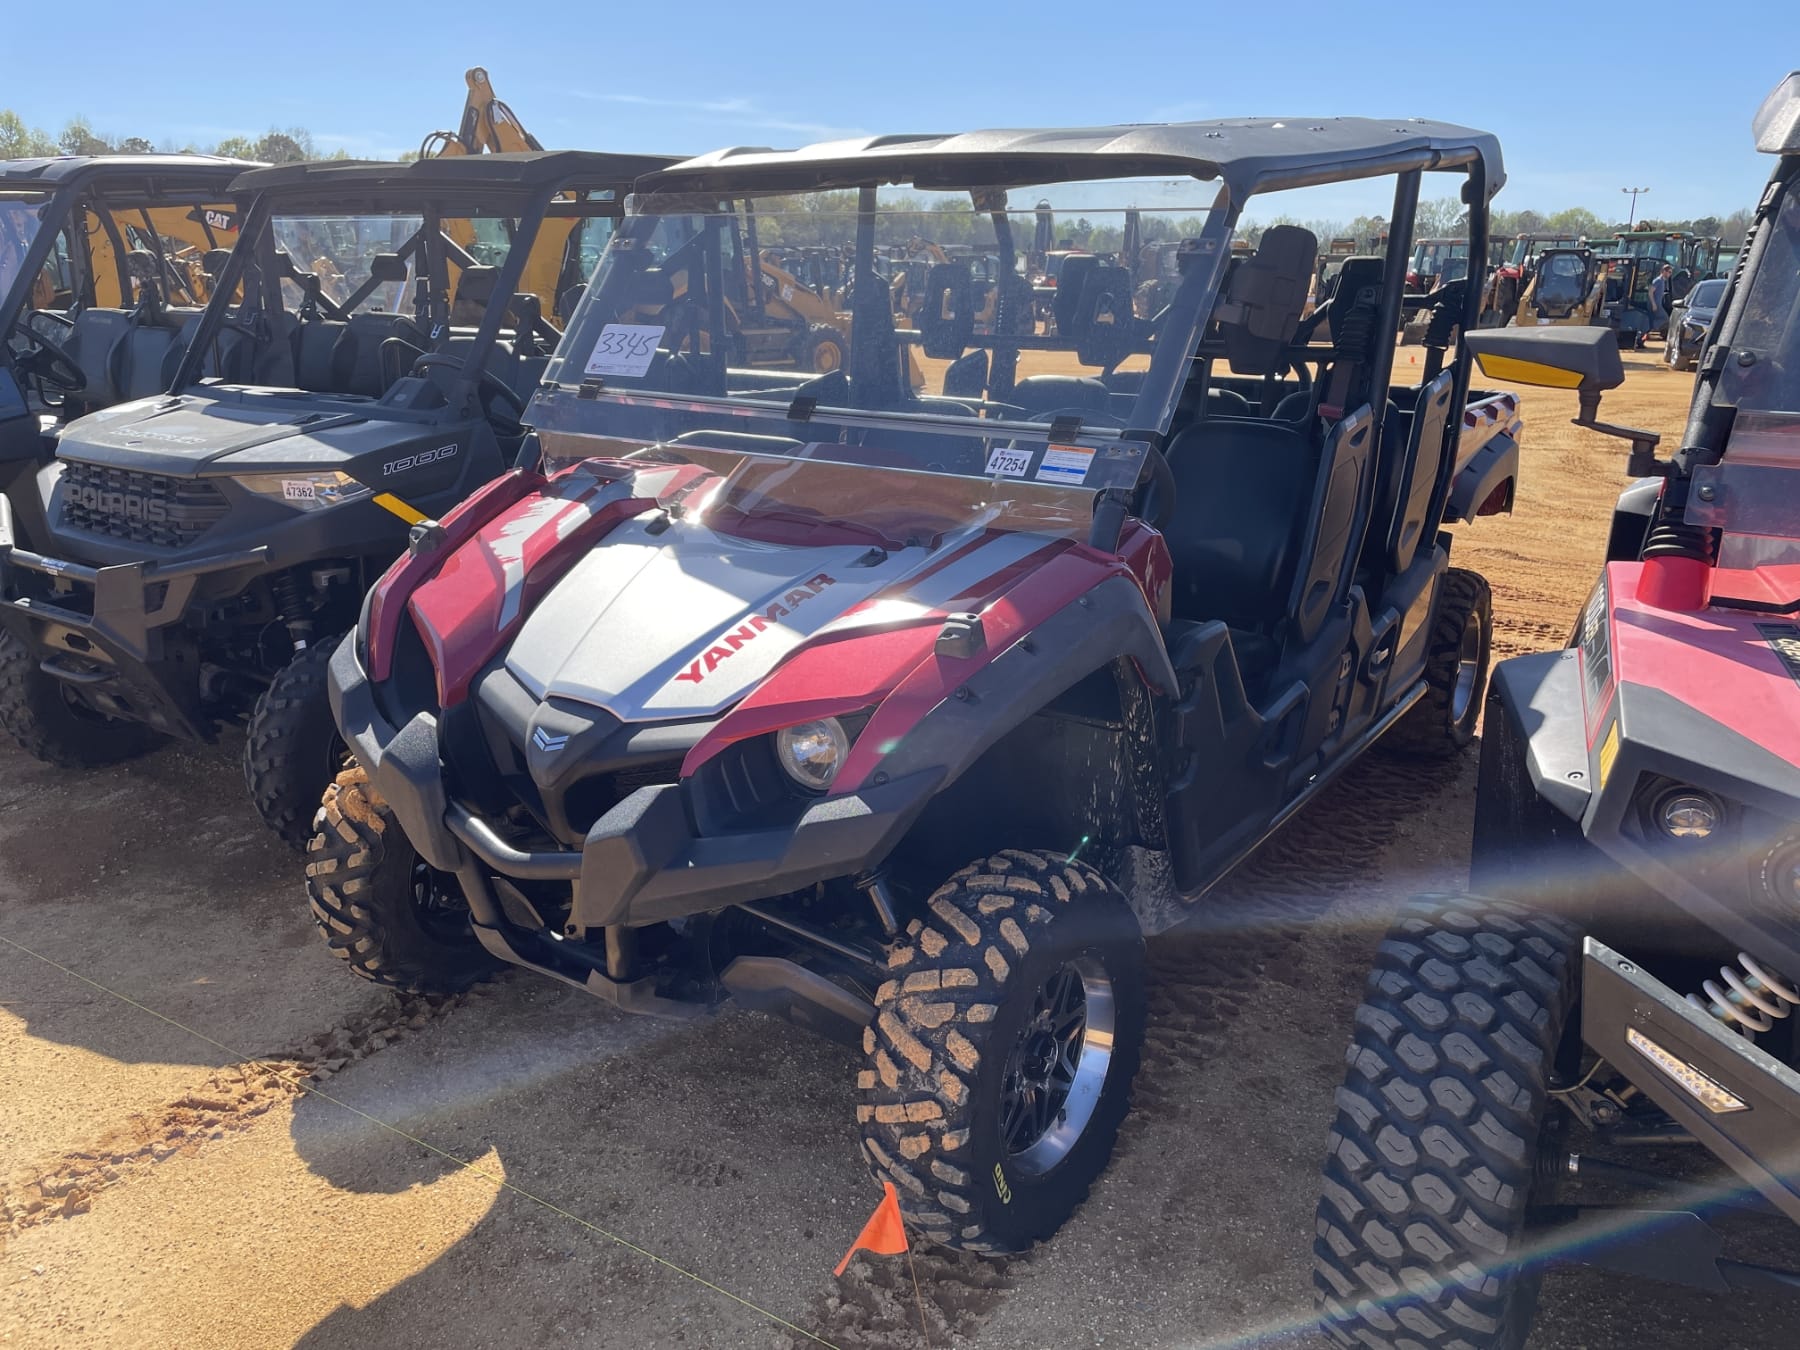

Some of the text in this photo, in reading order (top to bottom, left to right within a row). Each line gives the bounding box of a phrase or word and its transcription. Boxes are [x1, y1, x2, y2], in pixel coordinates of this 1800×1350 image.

[205, 210, 230, 230] CAT
[597, 332, 661, 360] 3345
[383, 443, 458, 476] 1000
[990, 456, 1027, 473] 47254
[63, 483, 168, 523] POLARIS
[286, 486, 313, 498] 47362
[674, 572, 837, 685] YANMAR
